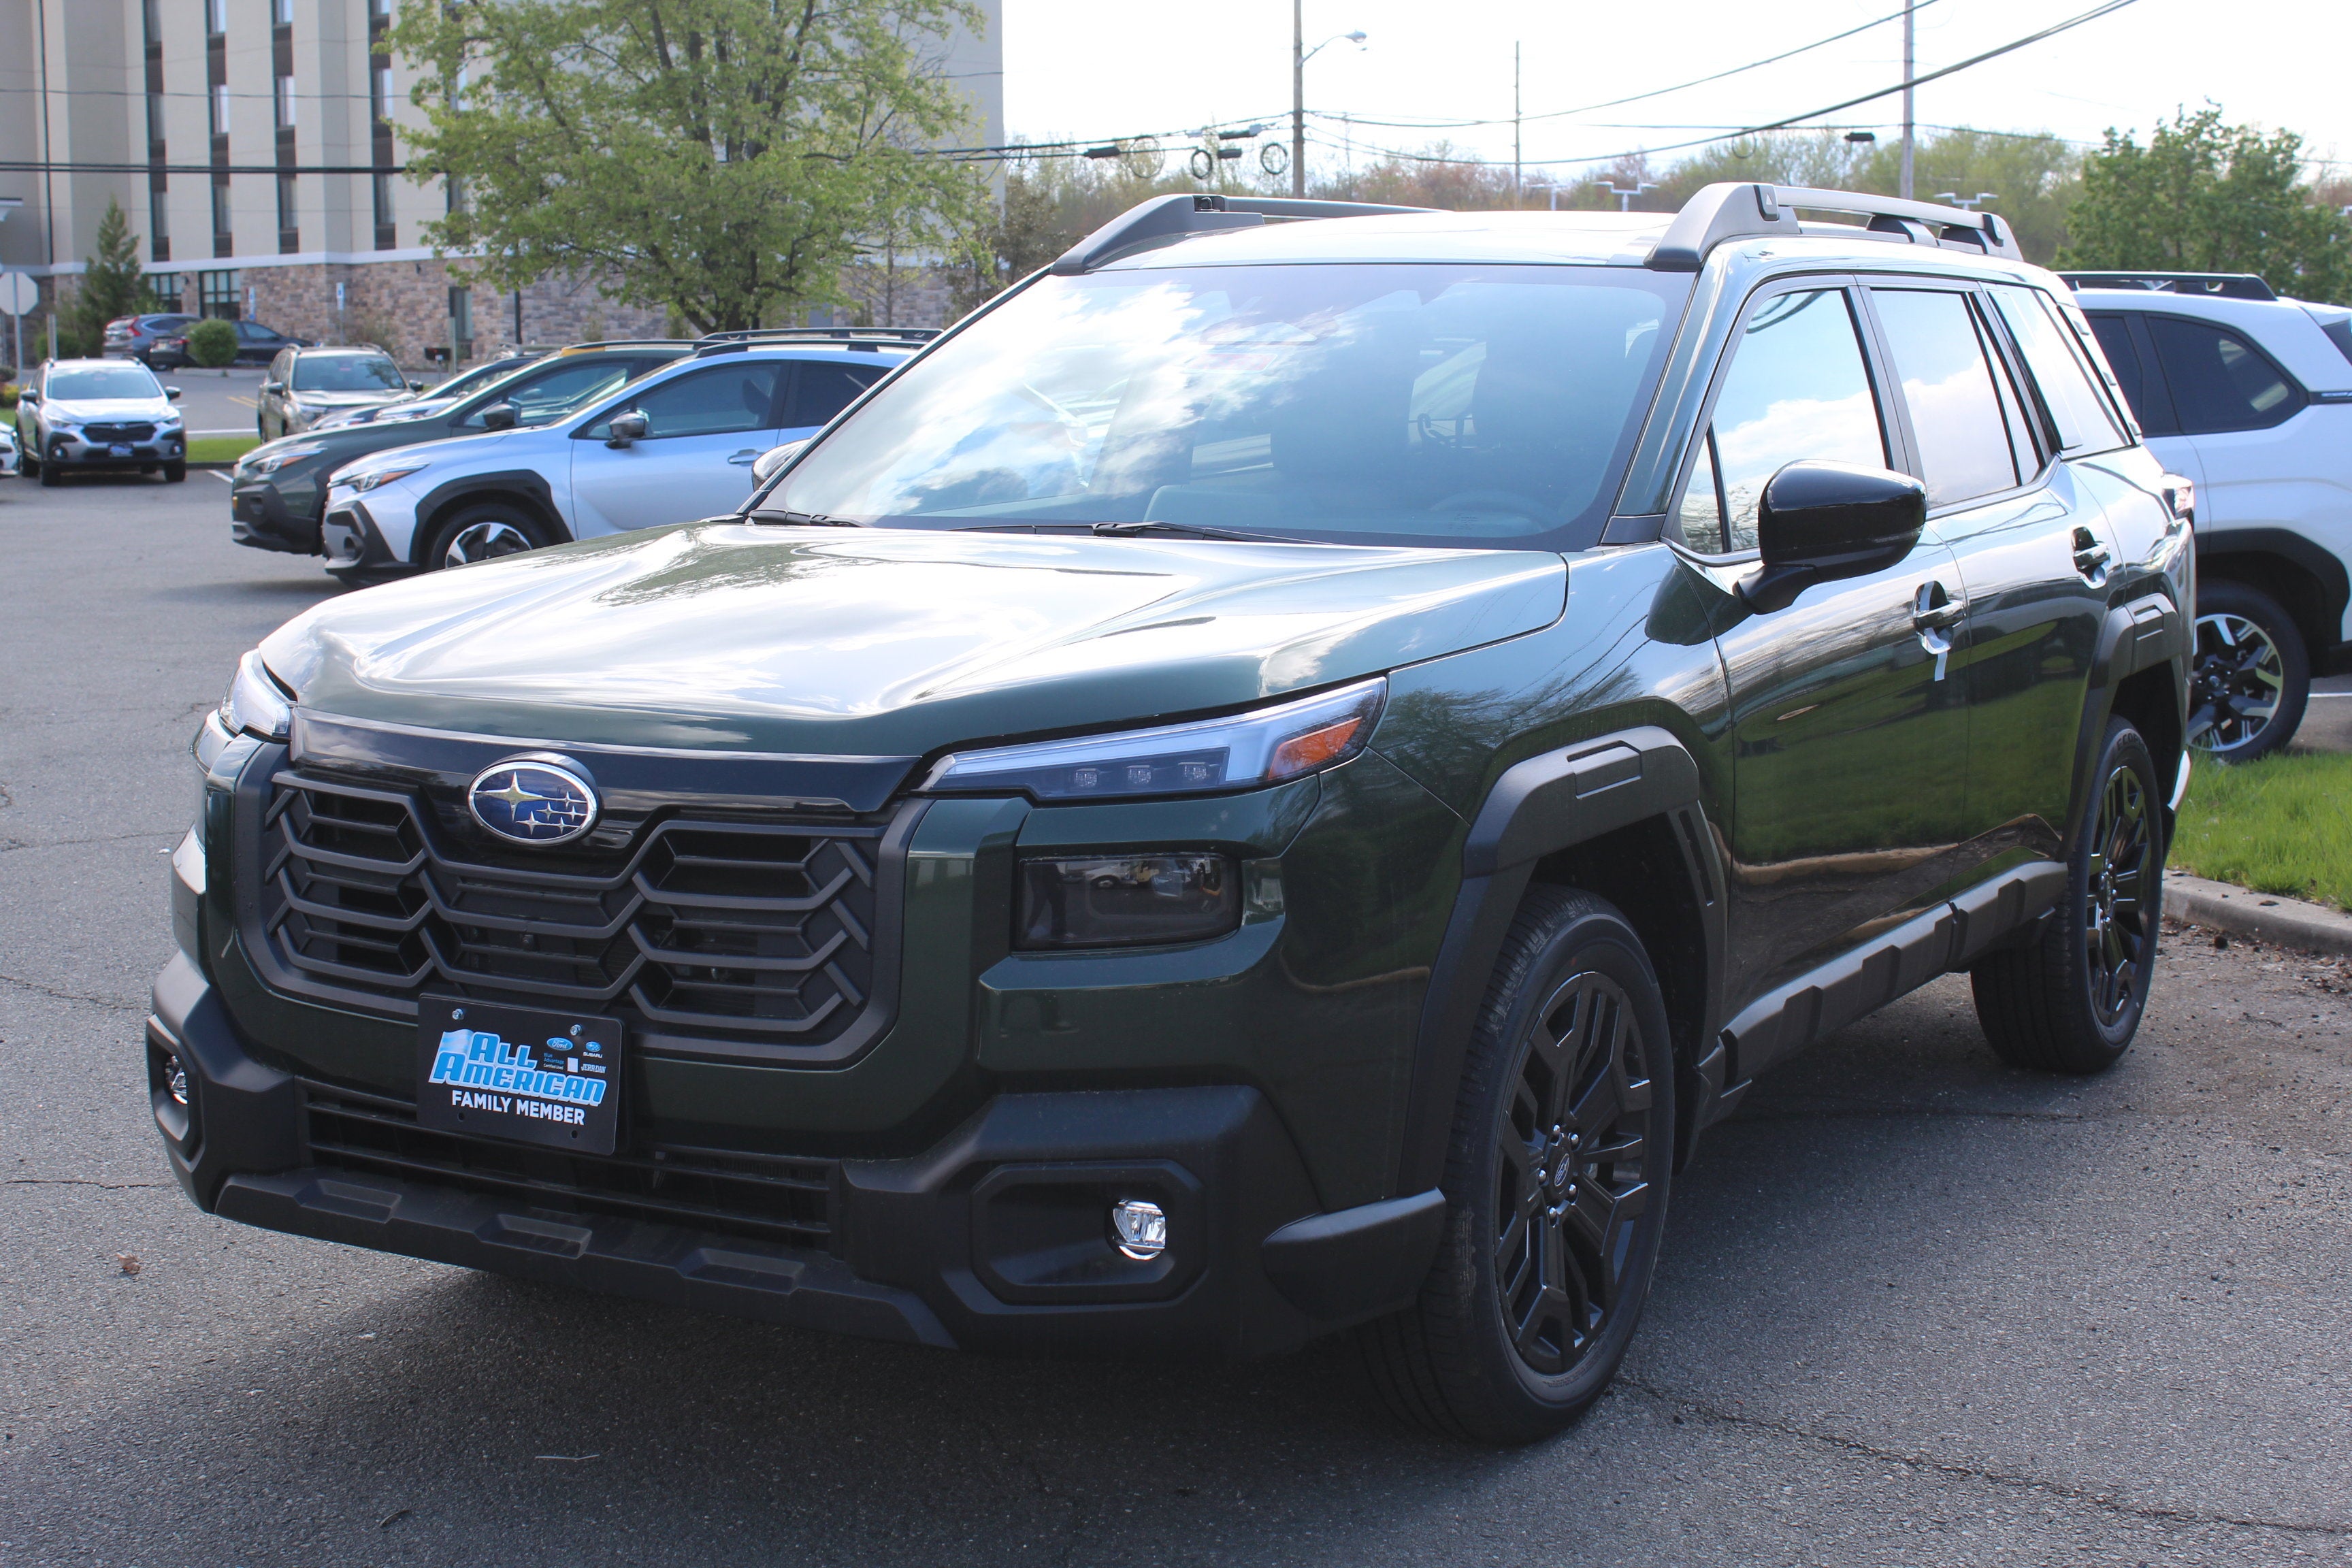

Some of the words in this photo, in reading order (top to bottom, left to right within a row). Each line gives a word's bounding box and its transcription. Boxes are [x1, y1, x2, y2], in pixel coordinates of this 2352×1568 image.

[468, 1032, 538, 1069] ALL
[552, 1039, 568, 1049] Ford
[428, 1051, 607, 1107] AMERICAN
[451, 1090, 512, 1113] FAMILY
[516, 1099, 585, 1126] MEMBER
